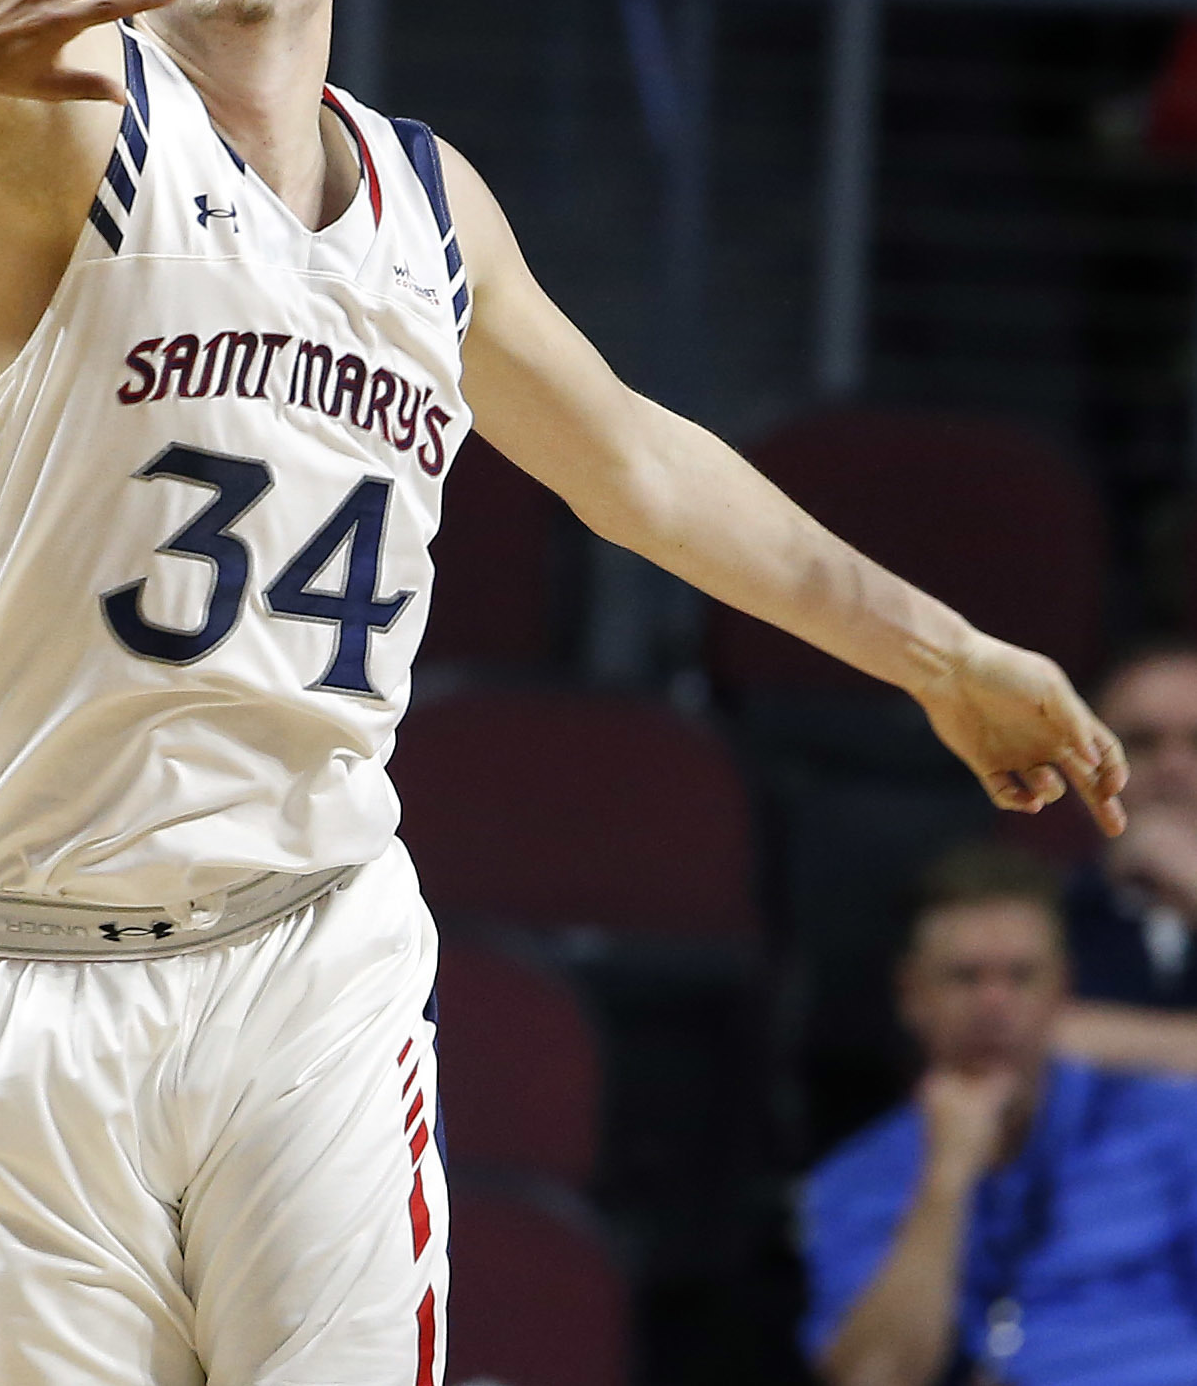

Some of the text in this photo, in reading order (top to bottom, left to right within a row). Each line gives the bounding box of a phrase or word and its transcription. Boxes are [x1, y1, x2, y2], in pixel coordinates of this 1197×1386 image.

[117, 331, 453, 478] SAINT MARY'S
[99, 441, 416, 700] 34
